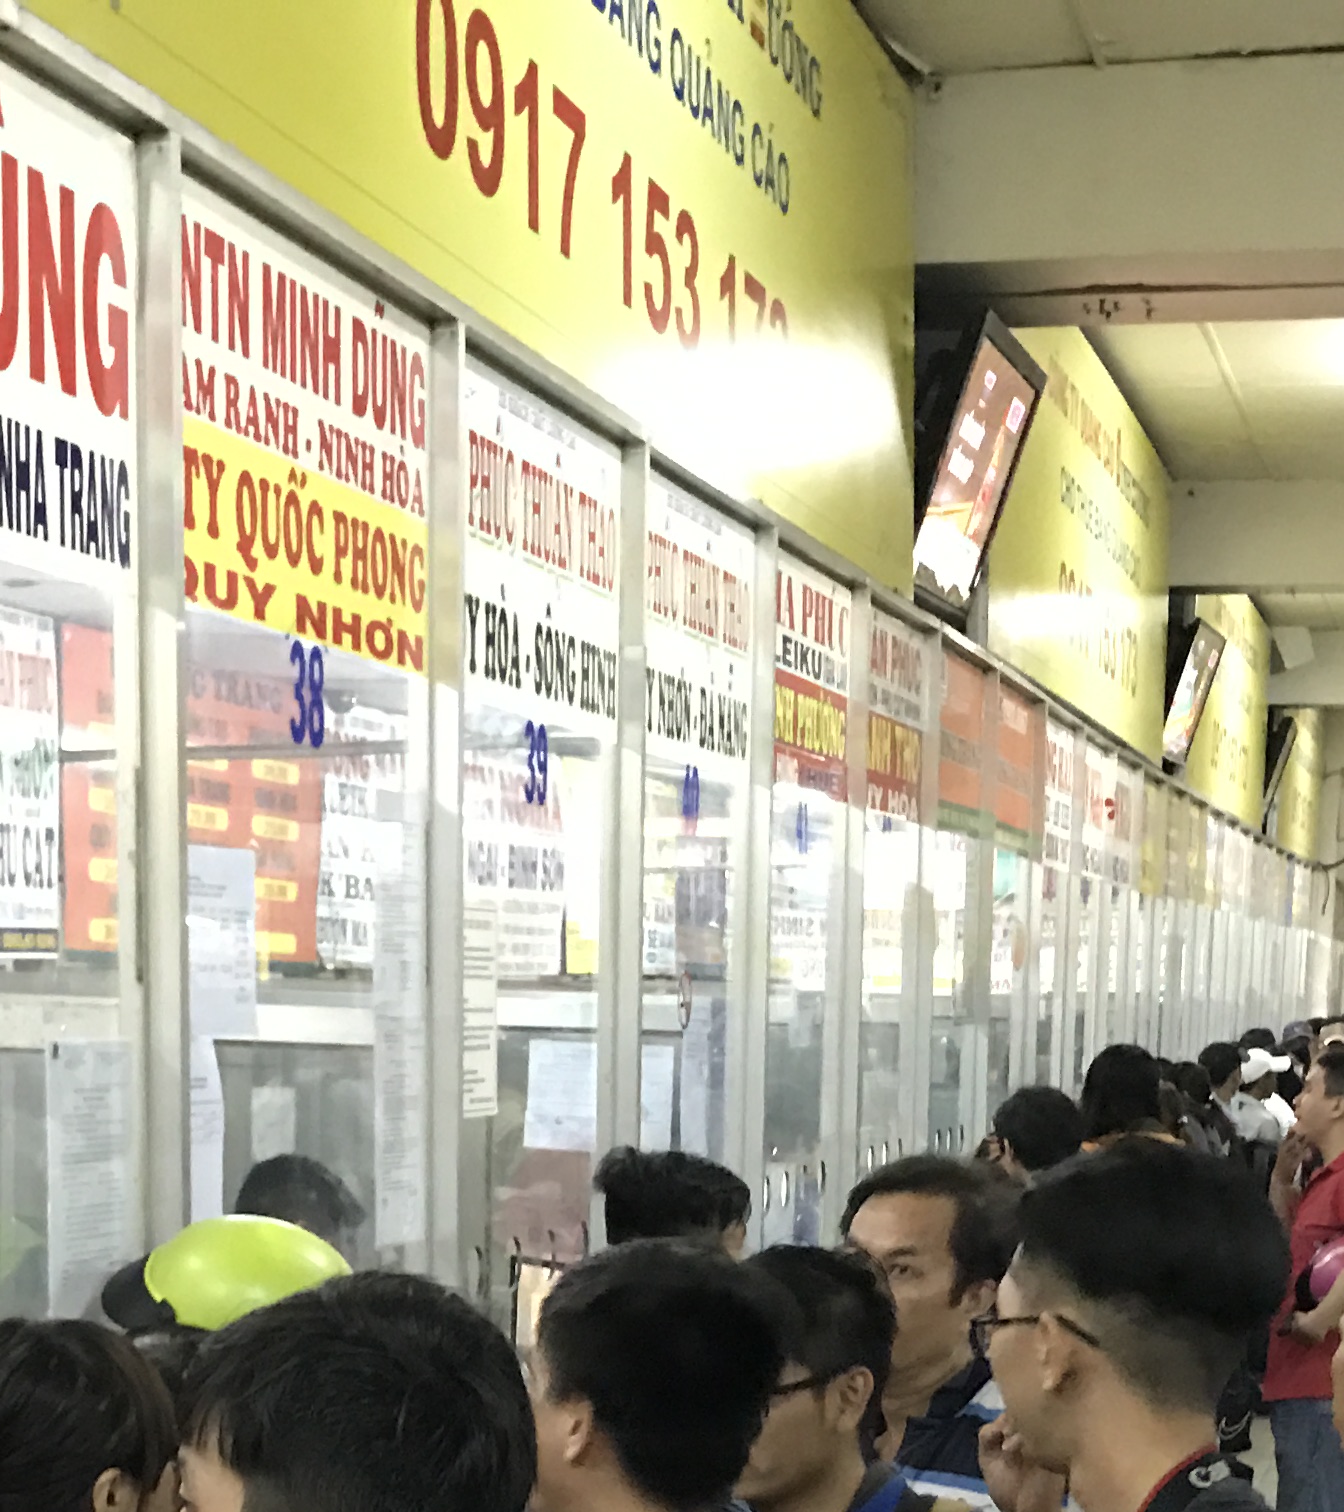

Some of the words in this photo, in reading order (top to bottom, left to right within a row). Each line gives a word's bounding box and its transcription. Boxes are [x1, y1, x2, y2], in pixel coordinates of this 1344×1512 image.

[416, 0, 586, 260] 0917
[611, 150, 701, 349] 153
[670, 35, 745, 169] QUẢNG
[751, 121, 791, 216] CÁO
[181, 213, 251, 360] NTN
[261, 262, 342, 407] MINH
[351, 299, 426, 451] DŨNG
[55, 436, 131, 569] TRANG
[224, 372, 299, 460] RANH
[317, 418, 375, 496] NINH
[380, 445, 426, 518] HÒA
[468, 414, 517, 551] PHÚC
[236, 466, 326, 576] QUỐC
[332, 509, 426, 615] PHONG
[290, 640, 324, 748] 38
[295, 594, 425, 672] NHƠN
[484, 582, 522, 691] HÒA
[534, 602, 577, 707] SÔNG
[580, 640, 617, 720] HINH
[524, 719, 550, 806] 39
